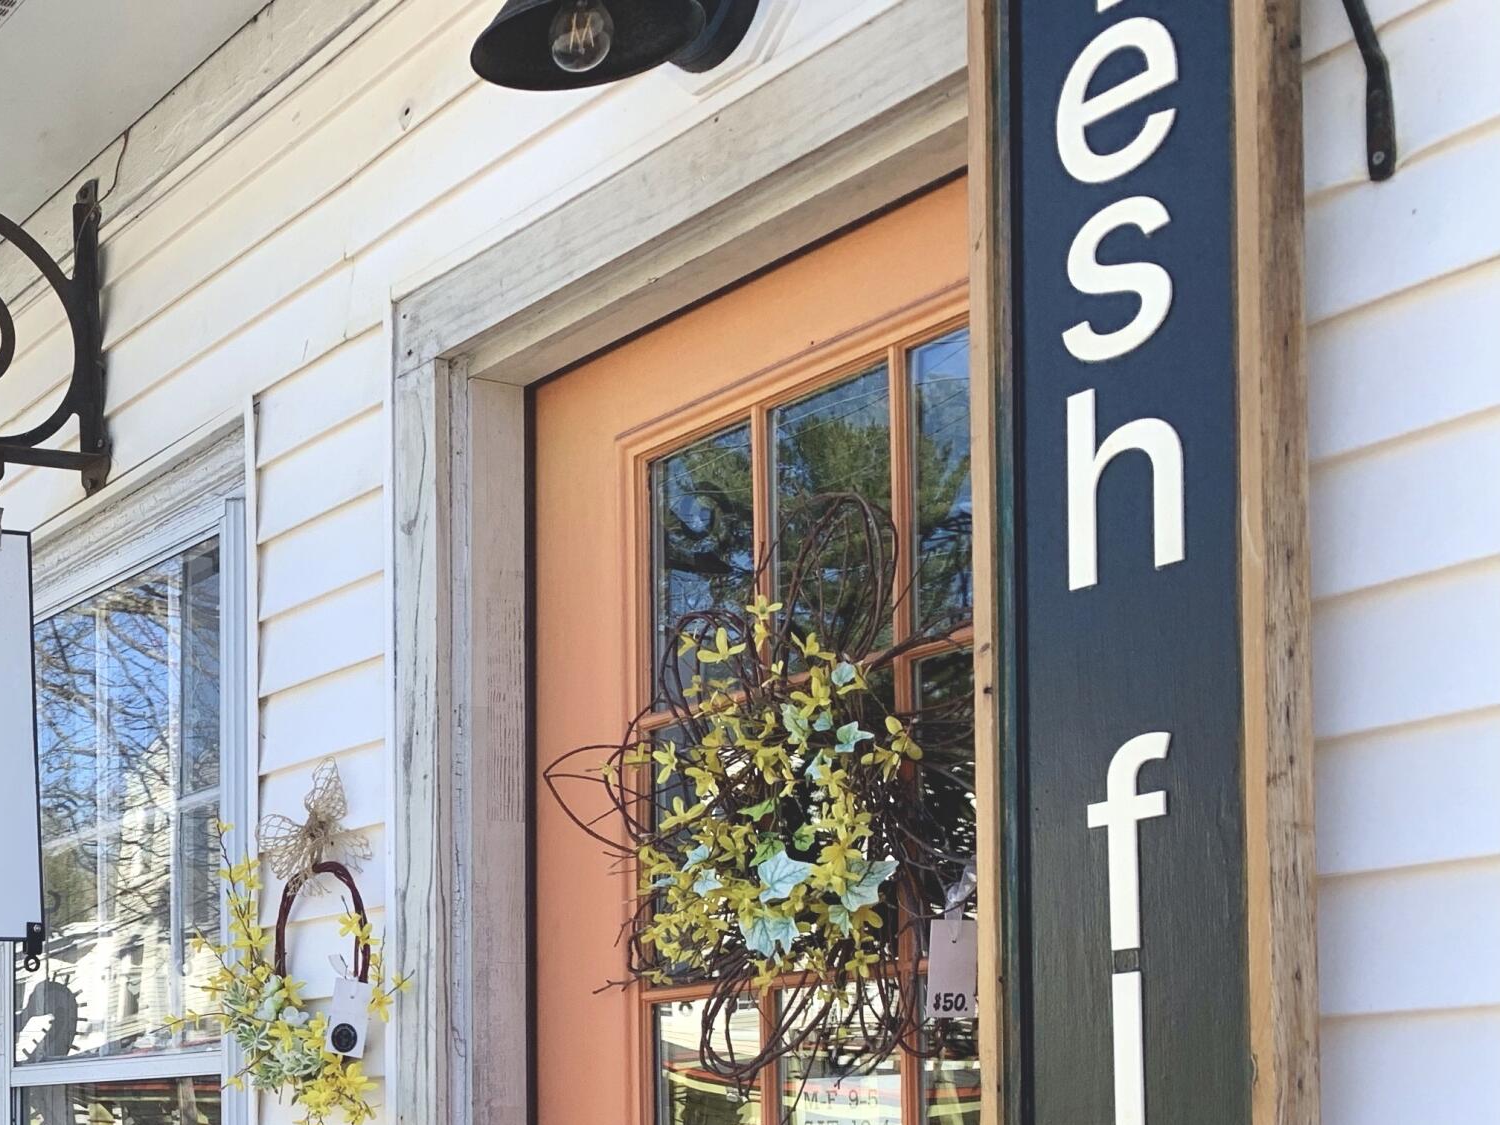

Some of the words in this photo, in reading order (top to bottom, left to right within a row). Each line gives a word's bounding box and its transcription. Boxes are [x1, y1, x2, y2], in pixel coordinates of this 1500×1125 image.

[1055, 0, 1186, 592] esh
[933, 992, 968, 1012] $50.
[848, 1089, 878, 1109] 9-5
